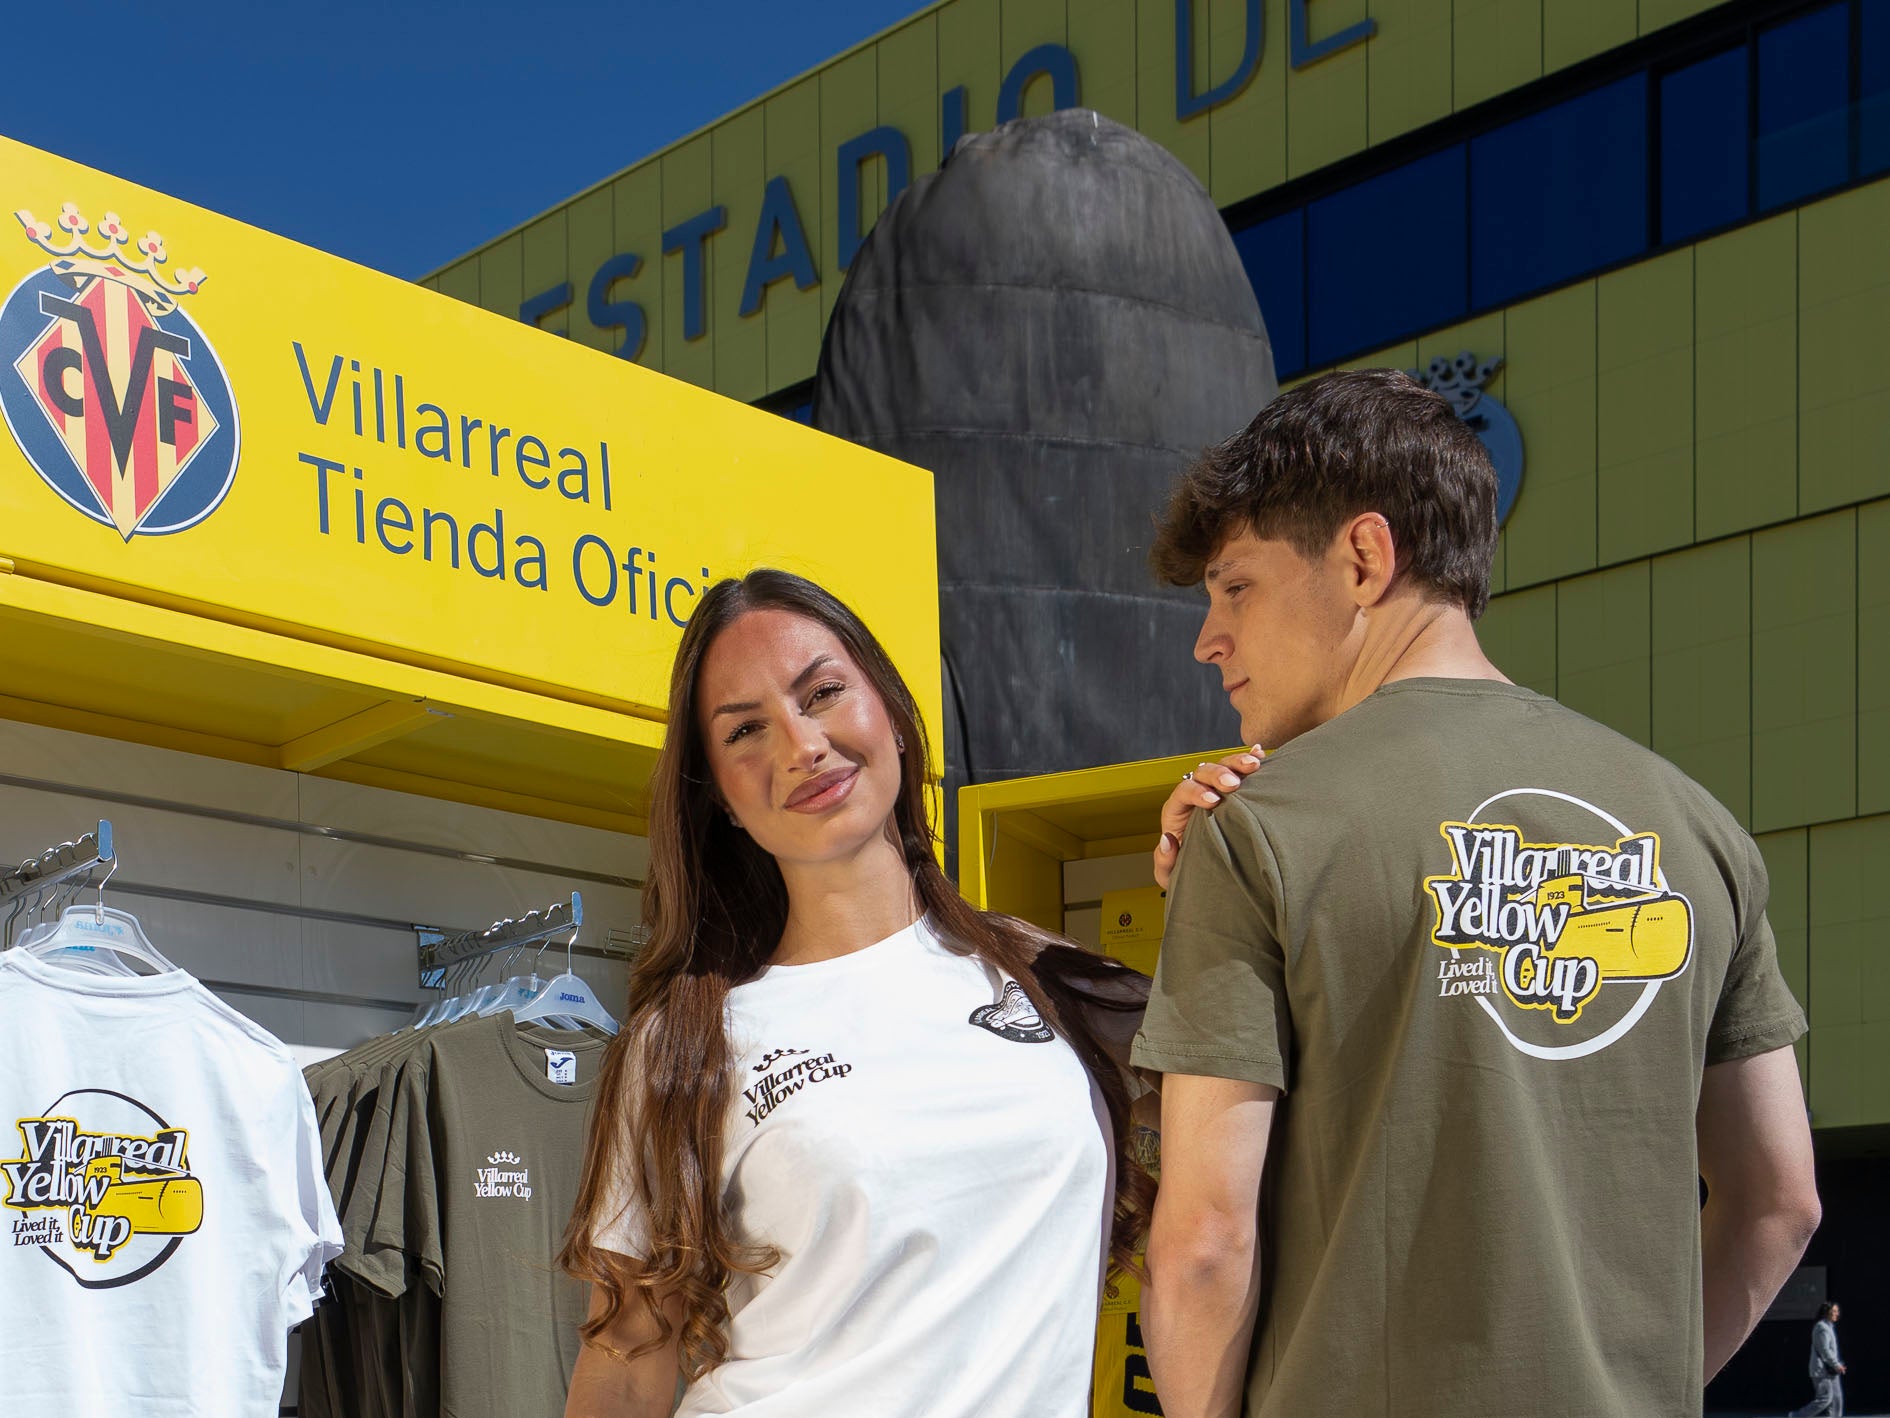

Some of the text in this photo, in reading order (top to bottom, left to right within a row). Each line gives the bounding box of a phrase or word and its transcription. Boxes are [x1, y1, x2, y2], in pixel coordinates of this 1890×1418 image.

[292, 341, 612, 511] Villarreal
[298, 452, 710, 629] Tienda Ofic
[1448, 828, 1654, 889] Villarreal
[1431, 882, 1570, 944] Yellow
[1547, 891, 1565, 901] 1923
[1437, 957, 1484, 978] Lived
[1439, 975, 1491, 997] Loved
[1504, 943, 1598, 1011] Cup
[560, 992, 585, 1003] Joma
[742, 1053, 837, 1105] Villarreal
[745, 1063, 852, 1128] Yellow Cup
[20, 1121, 186, 1170] Villarreal
[2, 1159, 111, 1205] Yellow
[474, 1183, 532, 1201] Yellow Cup
[477, 1168, 528, 1183] Villarreal
[12, 1217, 47, 1233] Lived
[14, 1230, 64, 1246] Loved it
[69, 1204, 131, 1255] Cup
